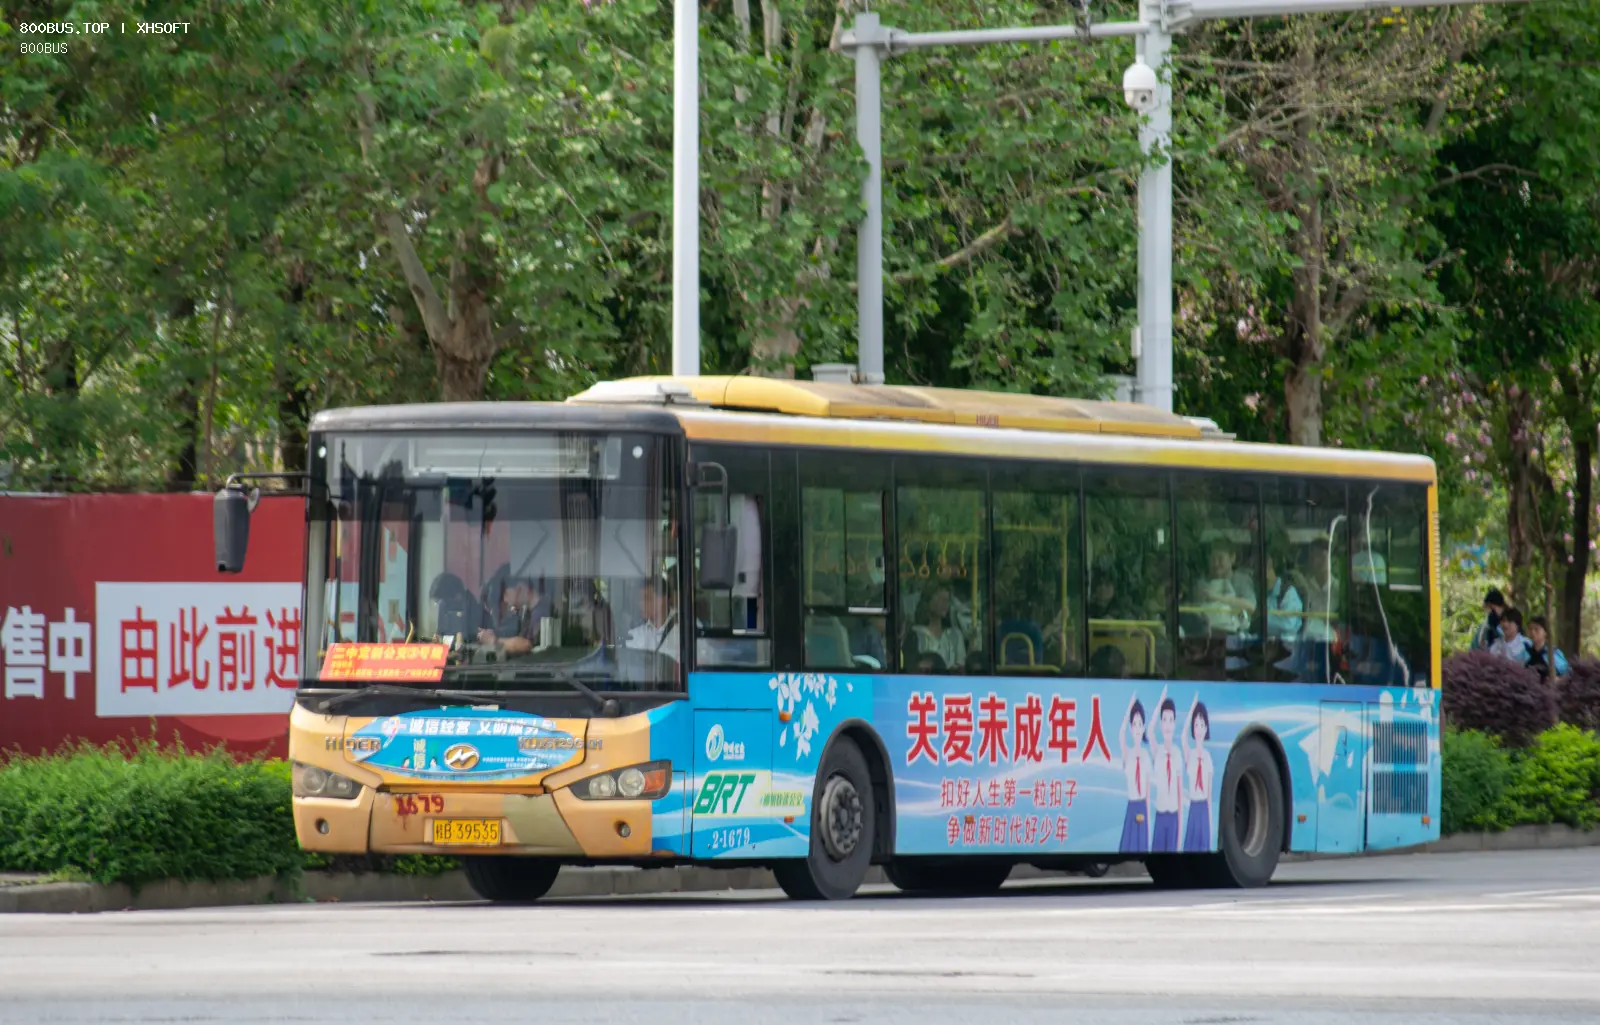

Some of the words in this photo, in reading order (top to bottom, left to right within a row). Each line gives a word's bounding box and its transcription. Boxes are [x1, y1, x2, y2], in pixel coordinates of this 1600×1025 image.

[0, 605, 92, 700] 售中
[119, 605, 301, 693] 由此前进
[906, 692, 1112, 764] 关爱未成年人
[694, 774, 757, 814] BRT
[940, 779, 1078, 808] 扣好人生第一粒扣子
[712, 828, 750, 849] 2-1679
[946, 815, 1069, 844] 争做新时代好少年
